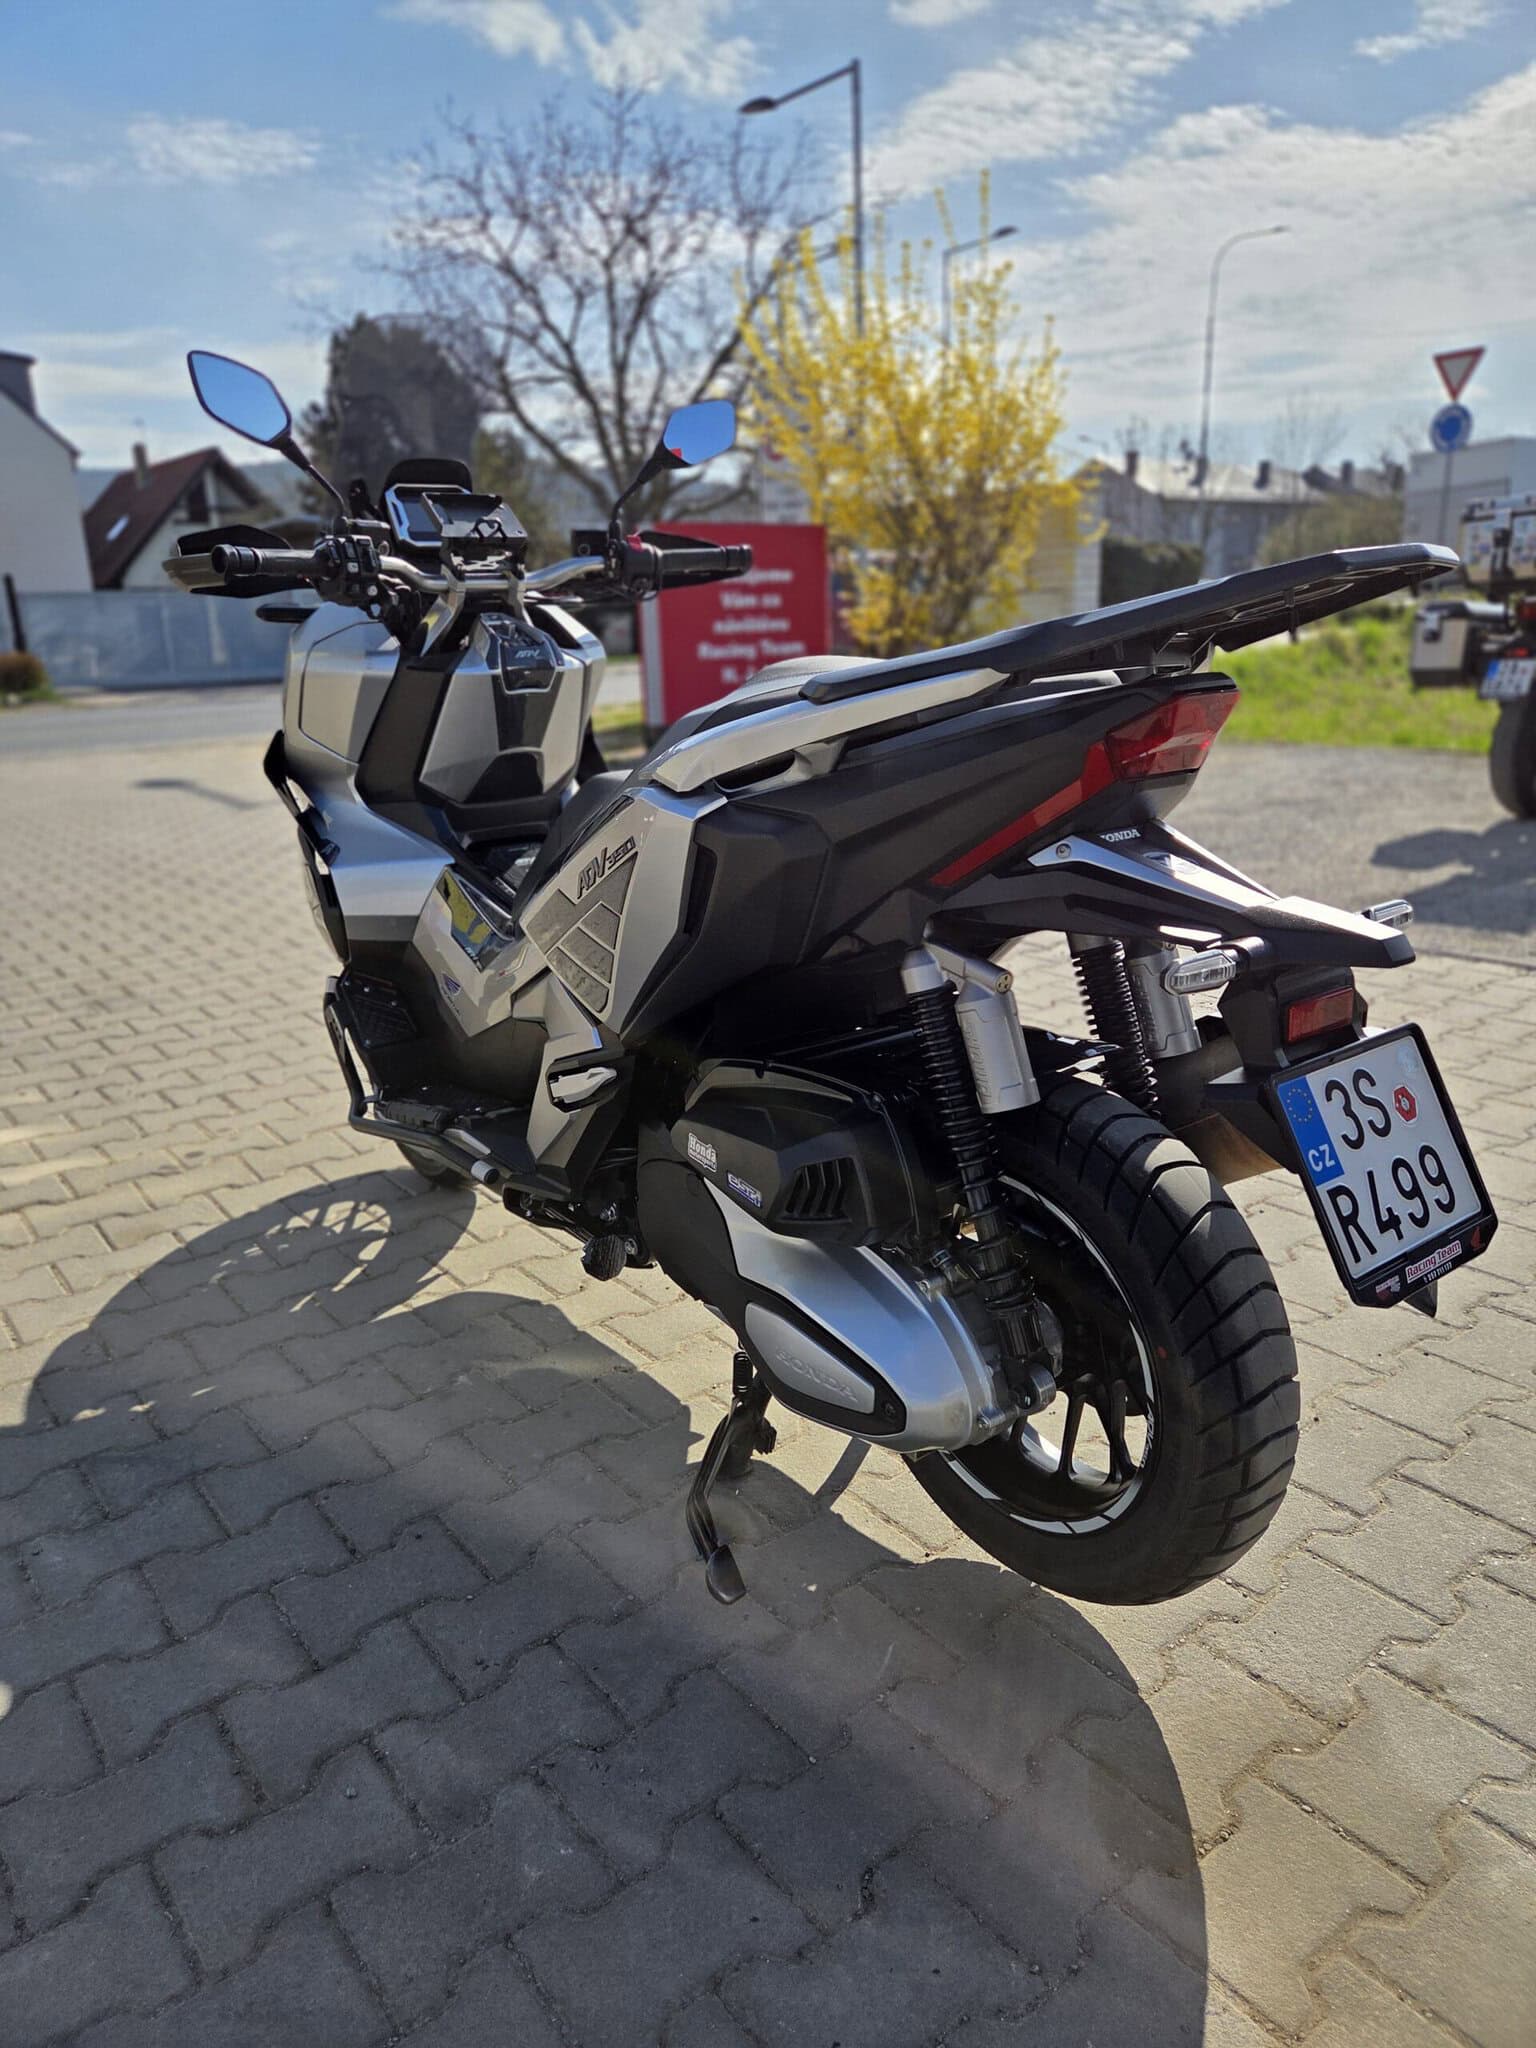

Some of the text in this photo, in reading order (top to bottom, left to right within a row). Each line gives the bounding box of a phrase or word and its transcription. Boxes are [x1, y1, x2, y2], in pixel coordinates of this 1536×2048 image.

[1100, 829, 1141, 842] ONDA
[577, 836, 637, 900] ADV 350
[1324, 1068, 1392, 1150] 3S
[689, 1134, 717, 1163] Honda
[1308, 1143, 1336, 1172] CZ
[1326, 1144, 1456, 1264] R499
[1407, 1241, 1461, 1278] Racing Team
